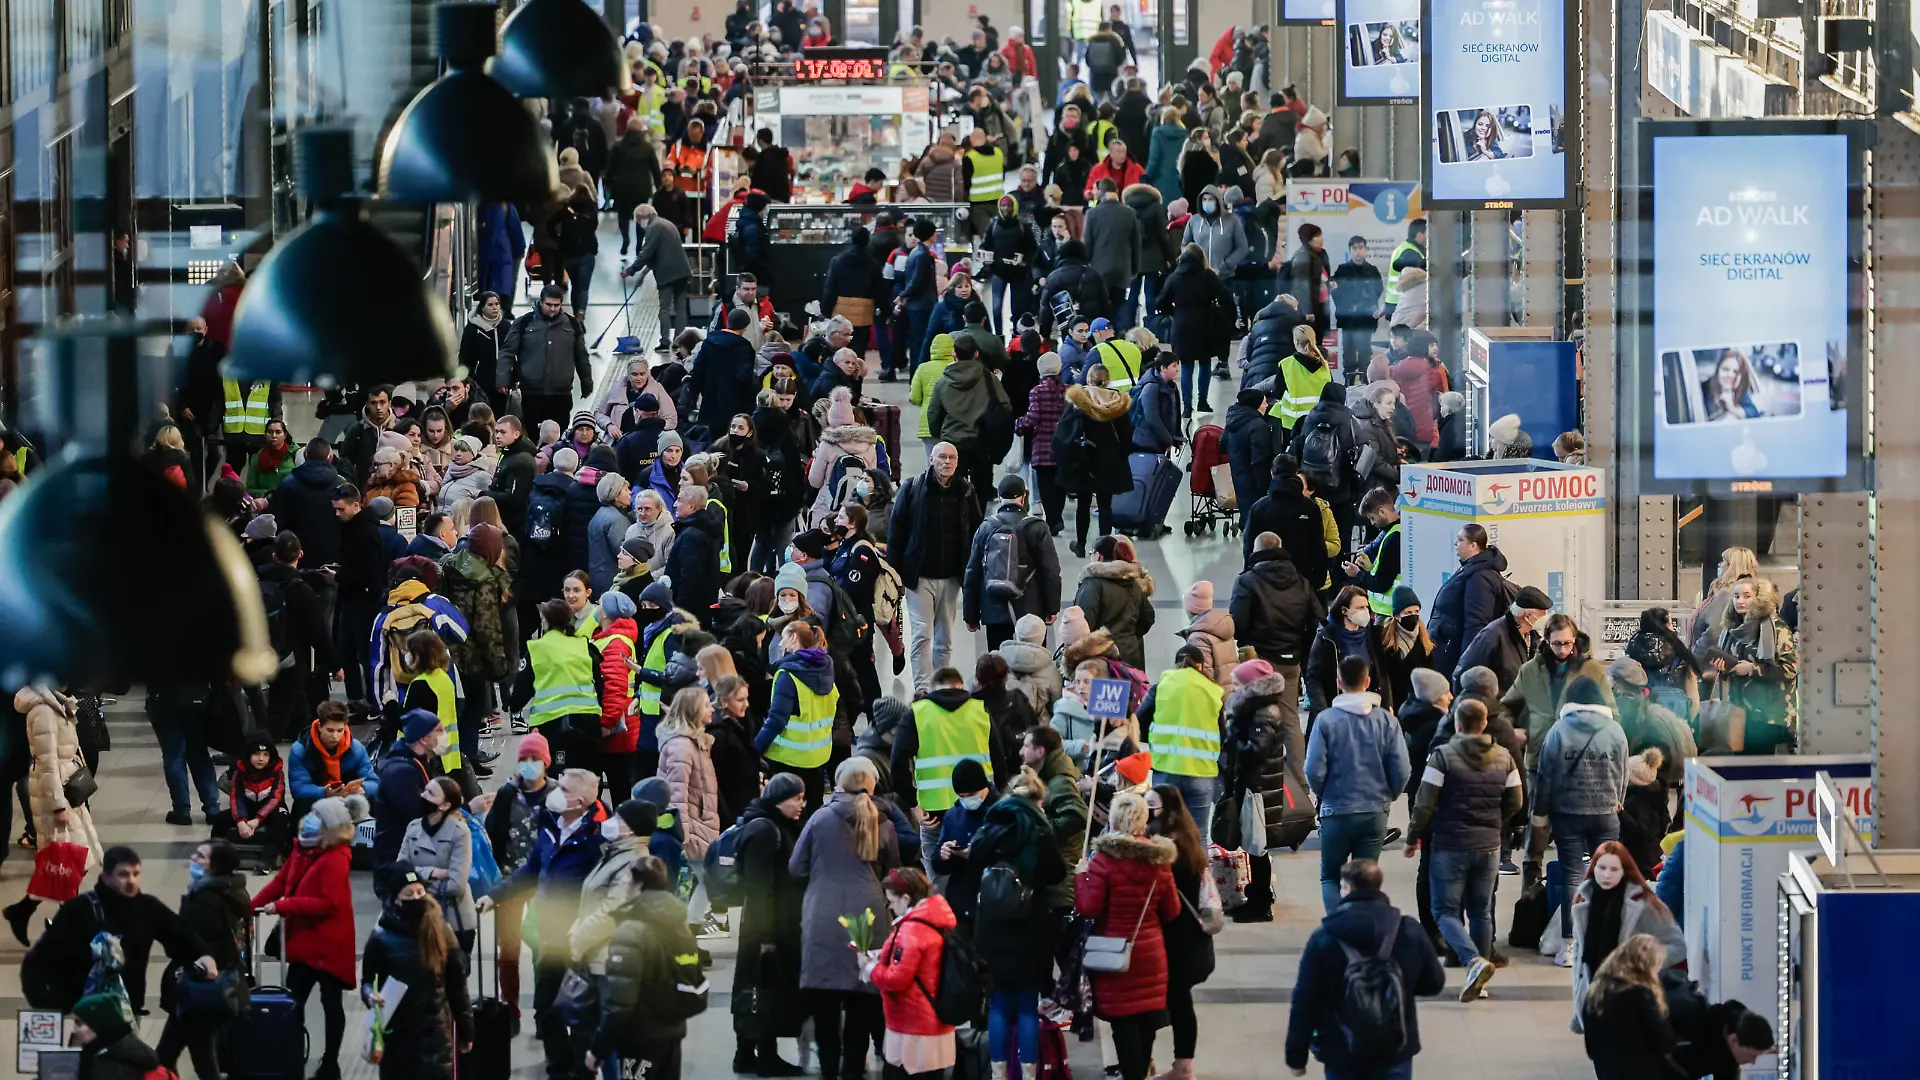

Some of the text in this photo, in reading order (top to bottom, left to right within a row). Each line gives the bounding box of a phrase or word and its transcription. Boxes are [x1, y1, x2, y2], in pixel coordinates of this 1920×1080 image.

[1460, 11, 1538, 25] AD WALK
[1462, 42, 1539, 53] SIEĆ EKRANÓW
[1481, 54, 1521, 62] DIGITAL
[1696, 205, 1810, 226] AD WALK
[1700, 251, 1811, 266] SIEĆ EKRANÓW
[1727, 268, 1783, 280] DIGITAL
[1426, 474, 1473, 498] ДОПОМОГА
[1519, 475, 1597, 501] POMOC
[1512, 499, 1597, 514] Dworzec kolejowy
[1097, 684, 1122, 701] JW
[1741, 848, 1753, 981] PUNKT INFORMACJI
